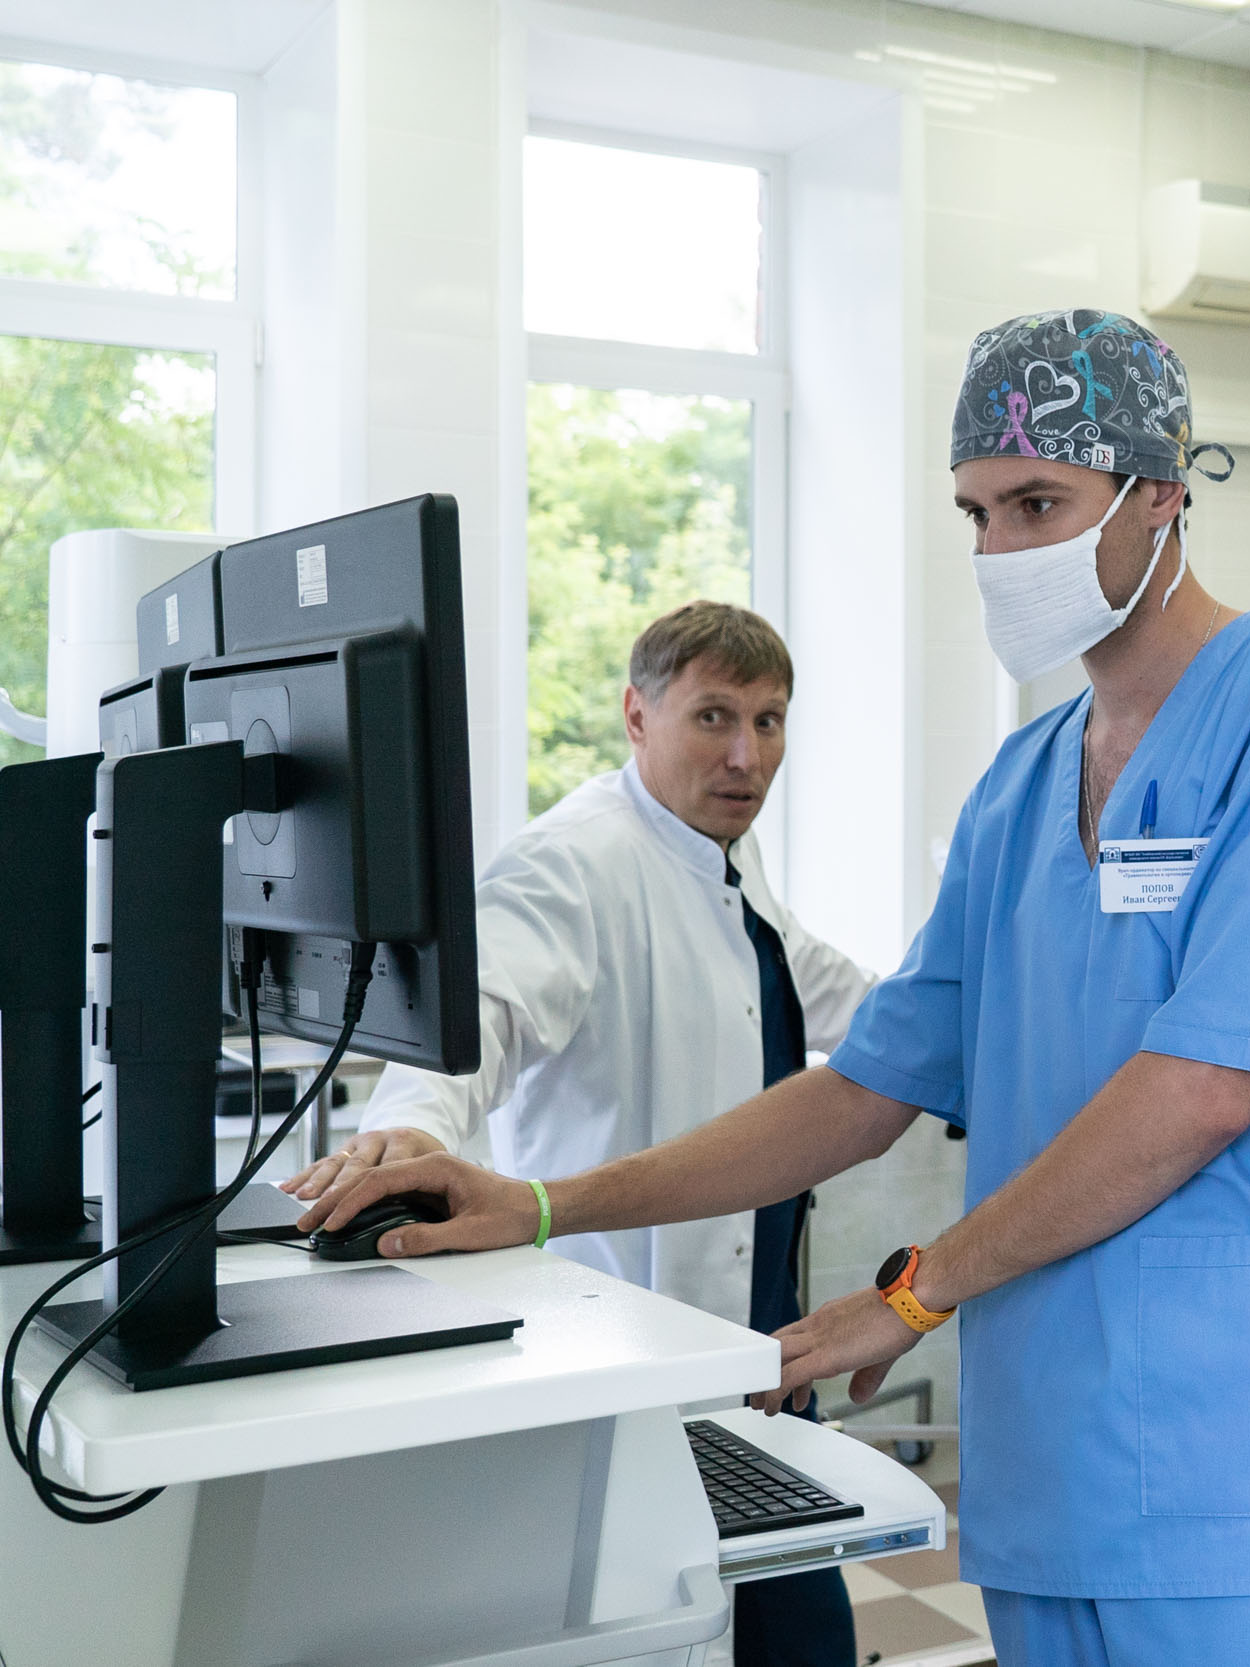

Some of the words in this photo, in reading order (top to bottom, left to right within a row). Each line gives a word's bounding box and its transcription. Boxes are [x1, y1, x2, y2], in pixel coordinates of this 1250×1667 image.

[1034, 424, 1060, 436] Love
[1141, 884, 1174, 893] ПОПОВ
[1122, 895, 1145, 904] Иван
